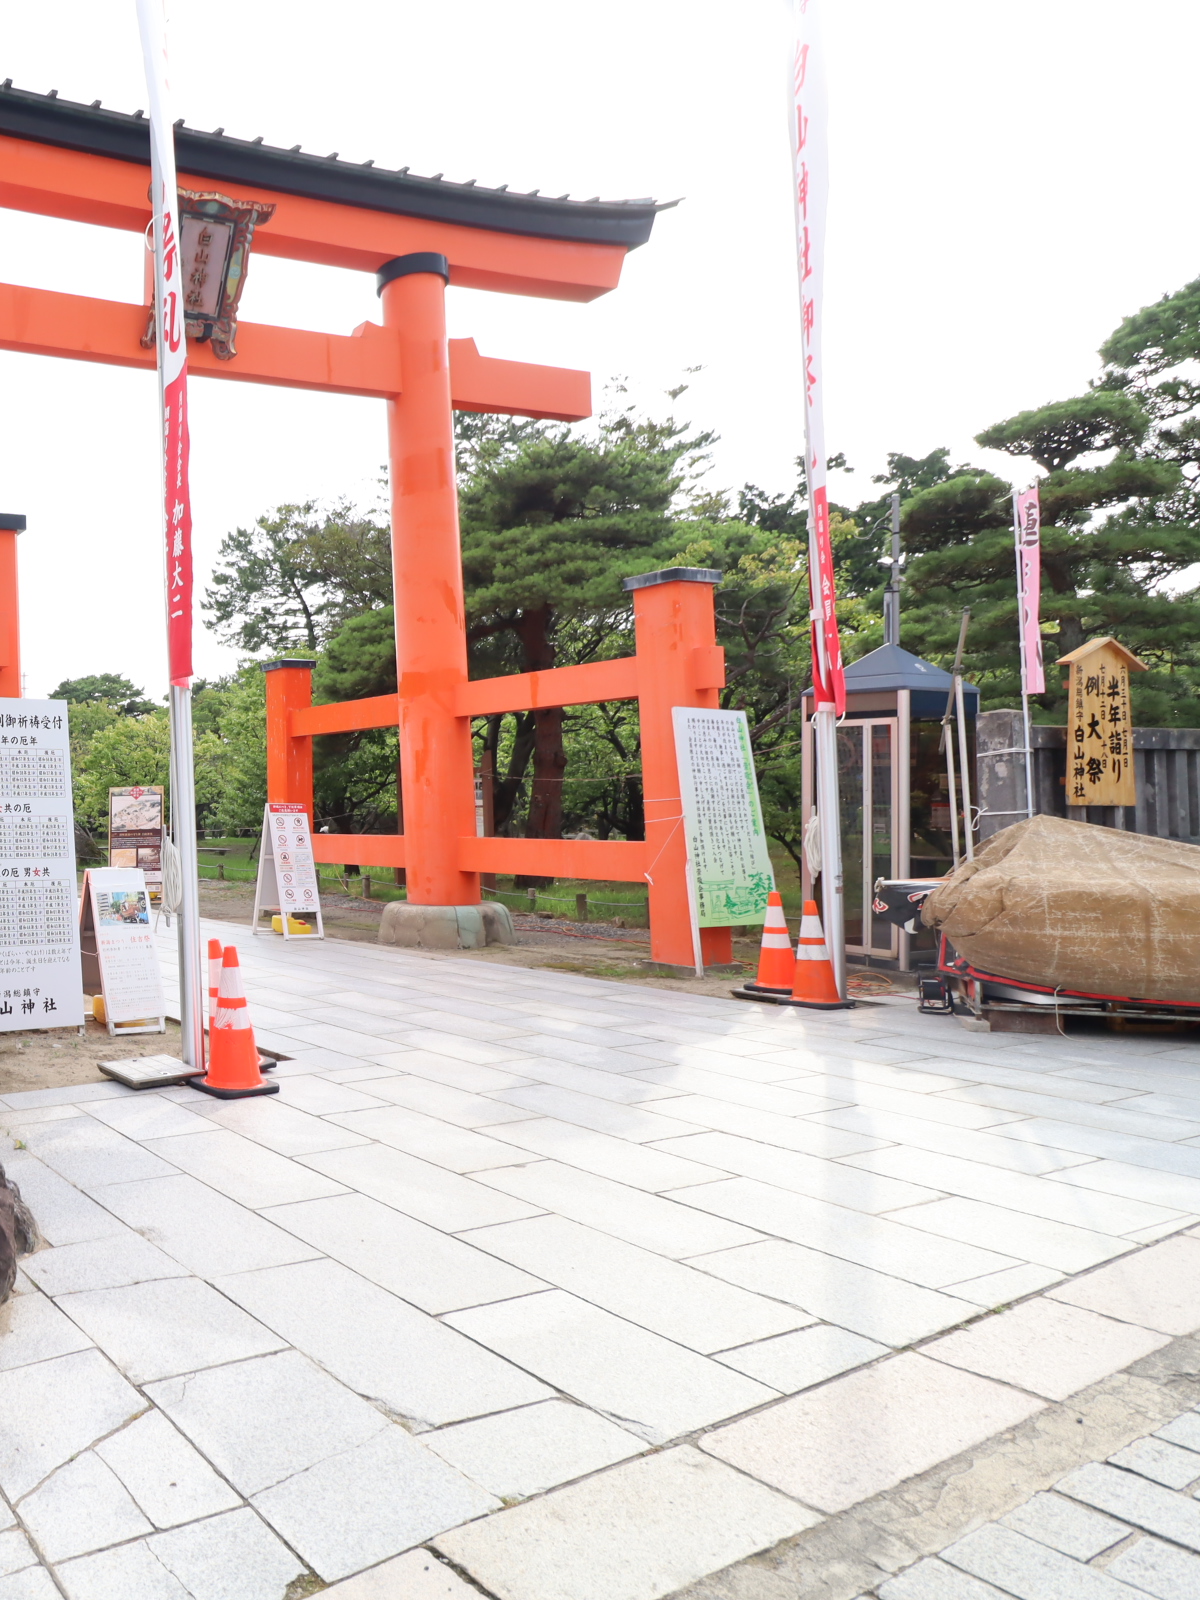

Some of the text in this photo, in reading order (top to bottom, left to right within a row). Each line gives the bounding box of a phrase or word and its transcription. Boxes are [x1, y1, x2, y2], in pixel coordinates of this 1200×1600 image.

[186, 226, 212, 310] 白山神社
[171, 499, 185, 619] 加藤大二
[1073, 724, 1086, 798] 白山神社
[1084, 674, 1104, 785] 例大祭
[1107, 674, 1122, 784] 半年詣り
[23, 866, 51, 877] 男女共
